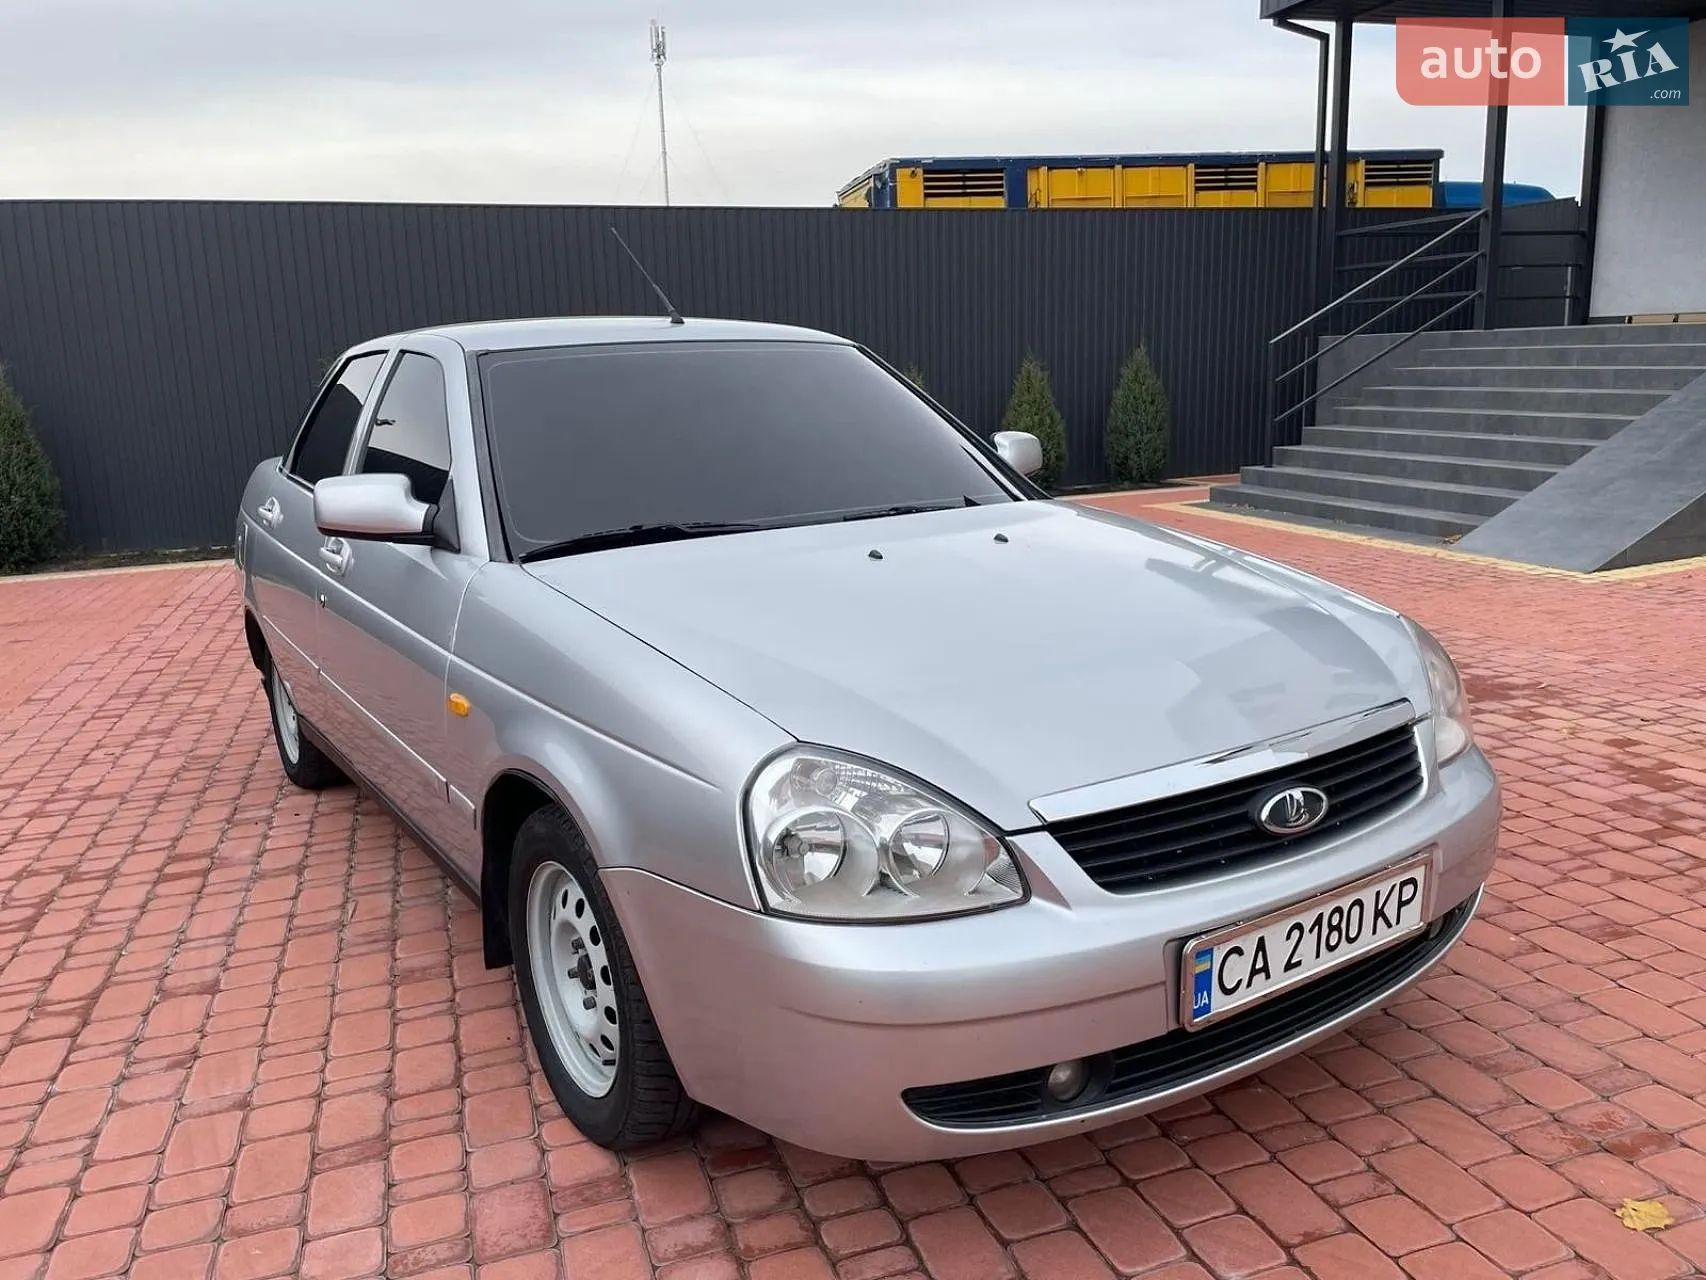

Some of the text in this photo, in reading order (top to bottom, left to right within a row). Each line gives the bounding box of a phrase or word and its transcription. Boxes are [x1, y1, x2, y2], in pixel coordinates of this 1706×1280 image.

[1217, 876, 1419, 996] CA 2180 KP
[1193, 990, 1209, 1009] UA
